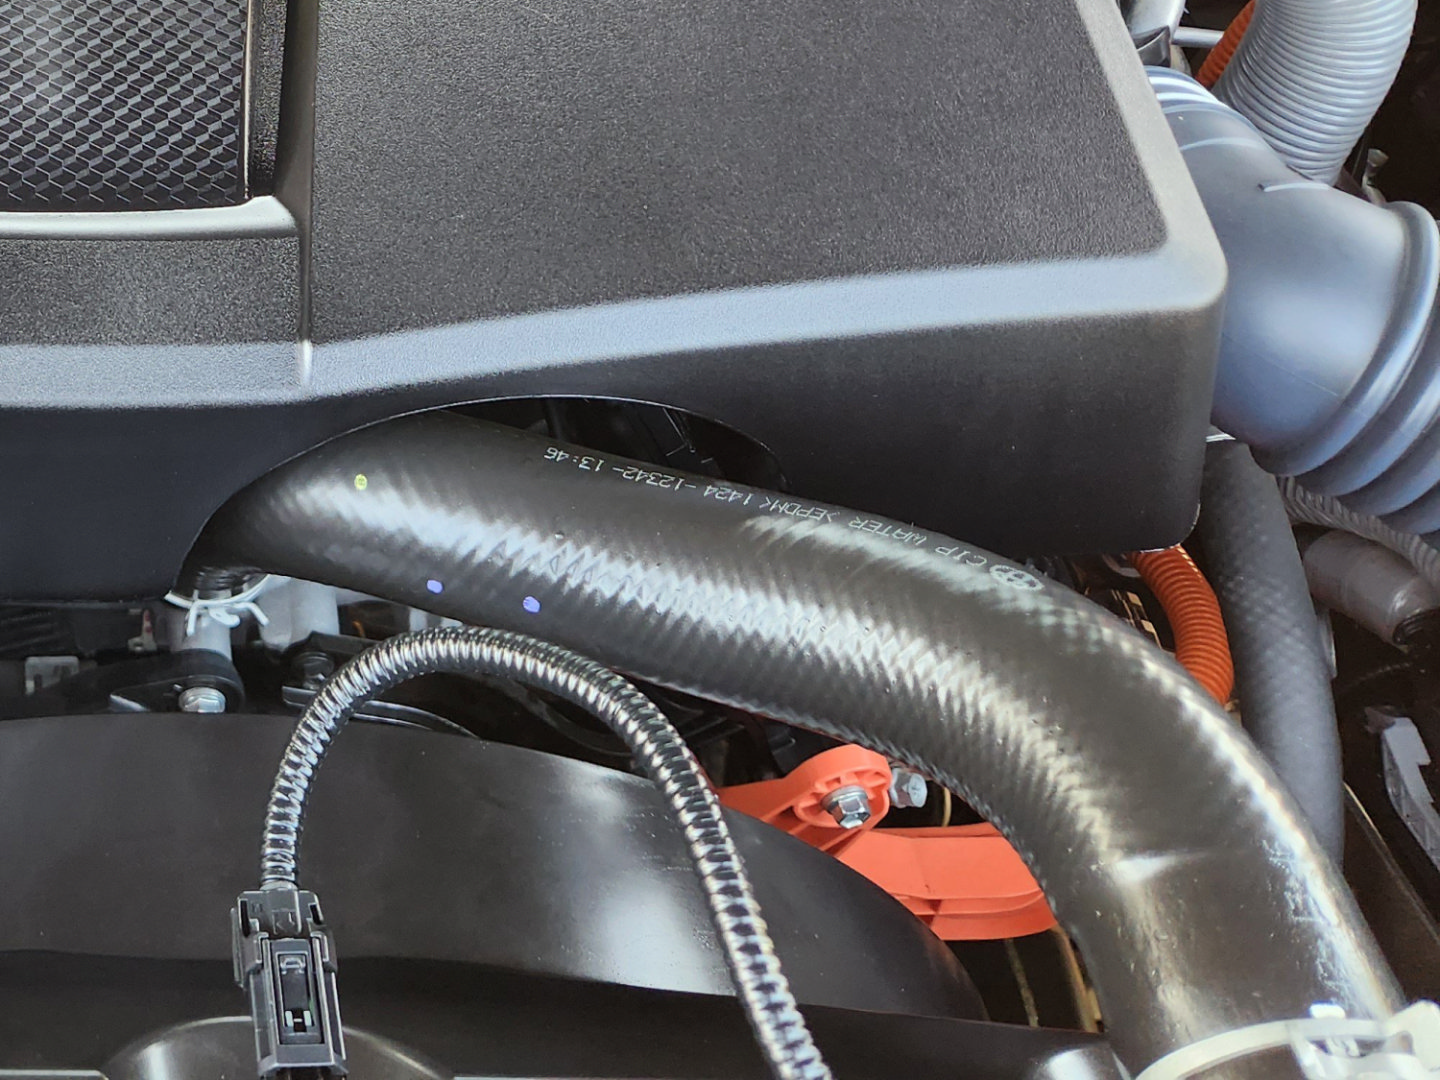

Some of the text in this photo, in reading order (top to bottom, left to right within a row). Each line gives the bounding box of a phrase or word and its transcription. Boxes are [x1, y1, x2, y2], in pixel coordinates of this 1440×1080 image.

[543, 446, 606, 472] 13:46
[703, 484, 754, 506] 1424
[848, 516, 927, 546] WATER
[935, 545, 988, 567] CIP
